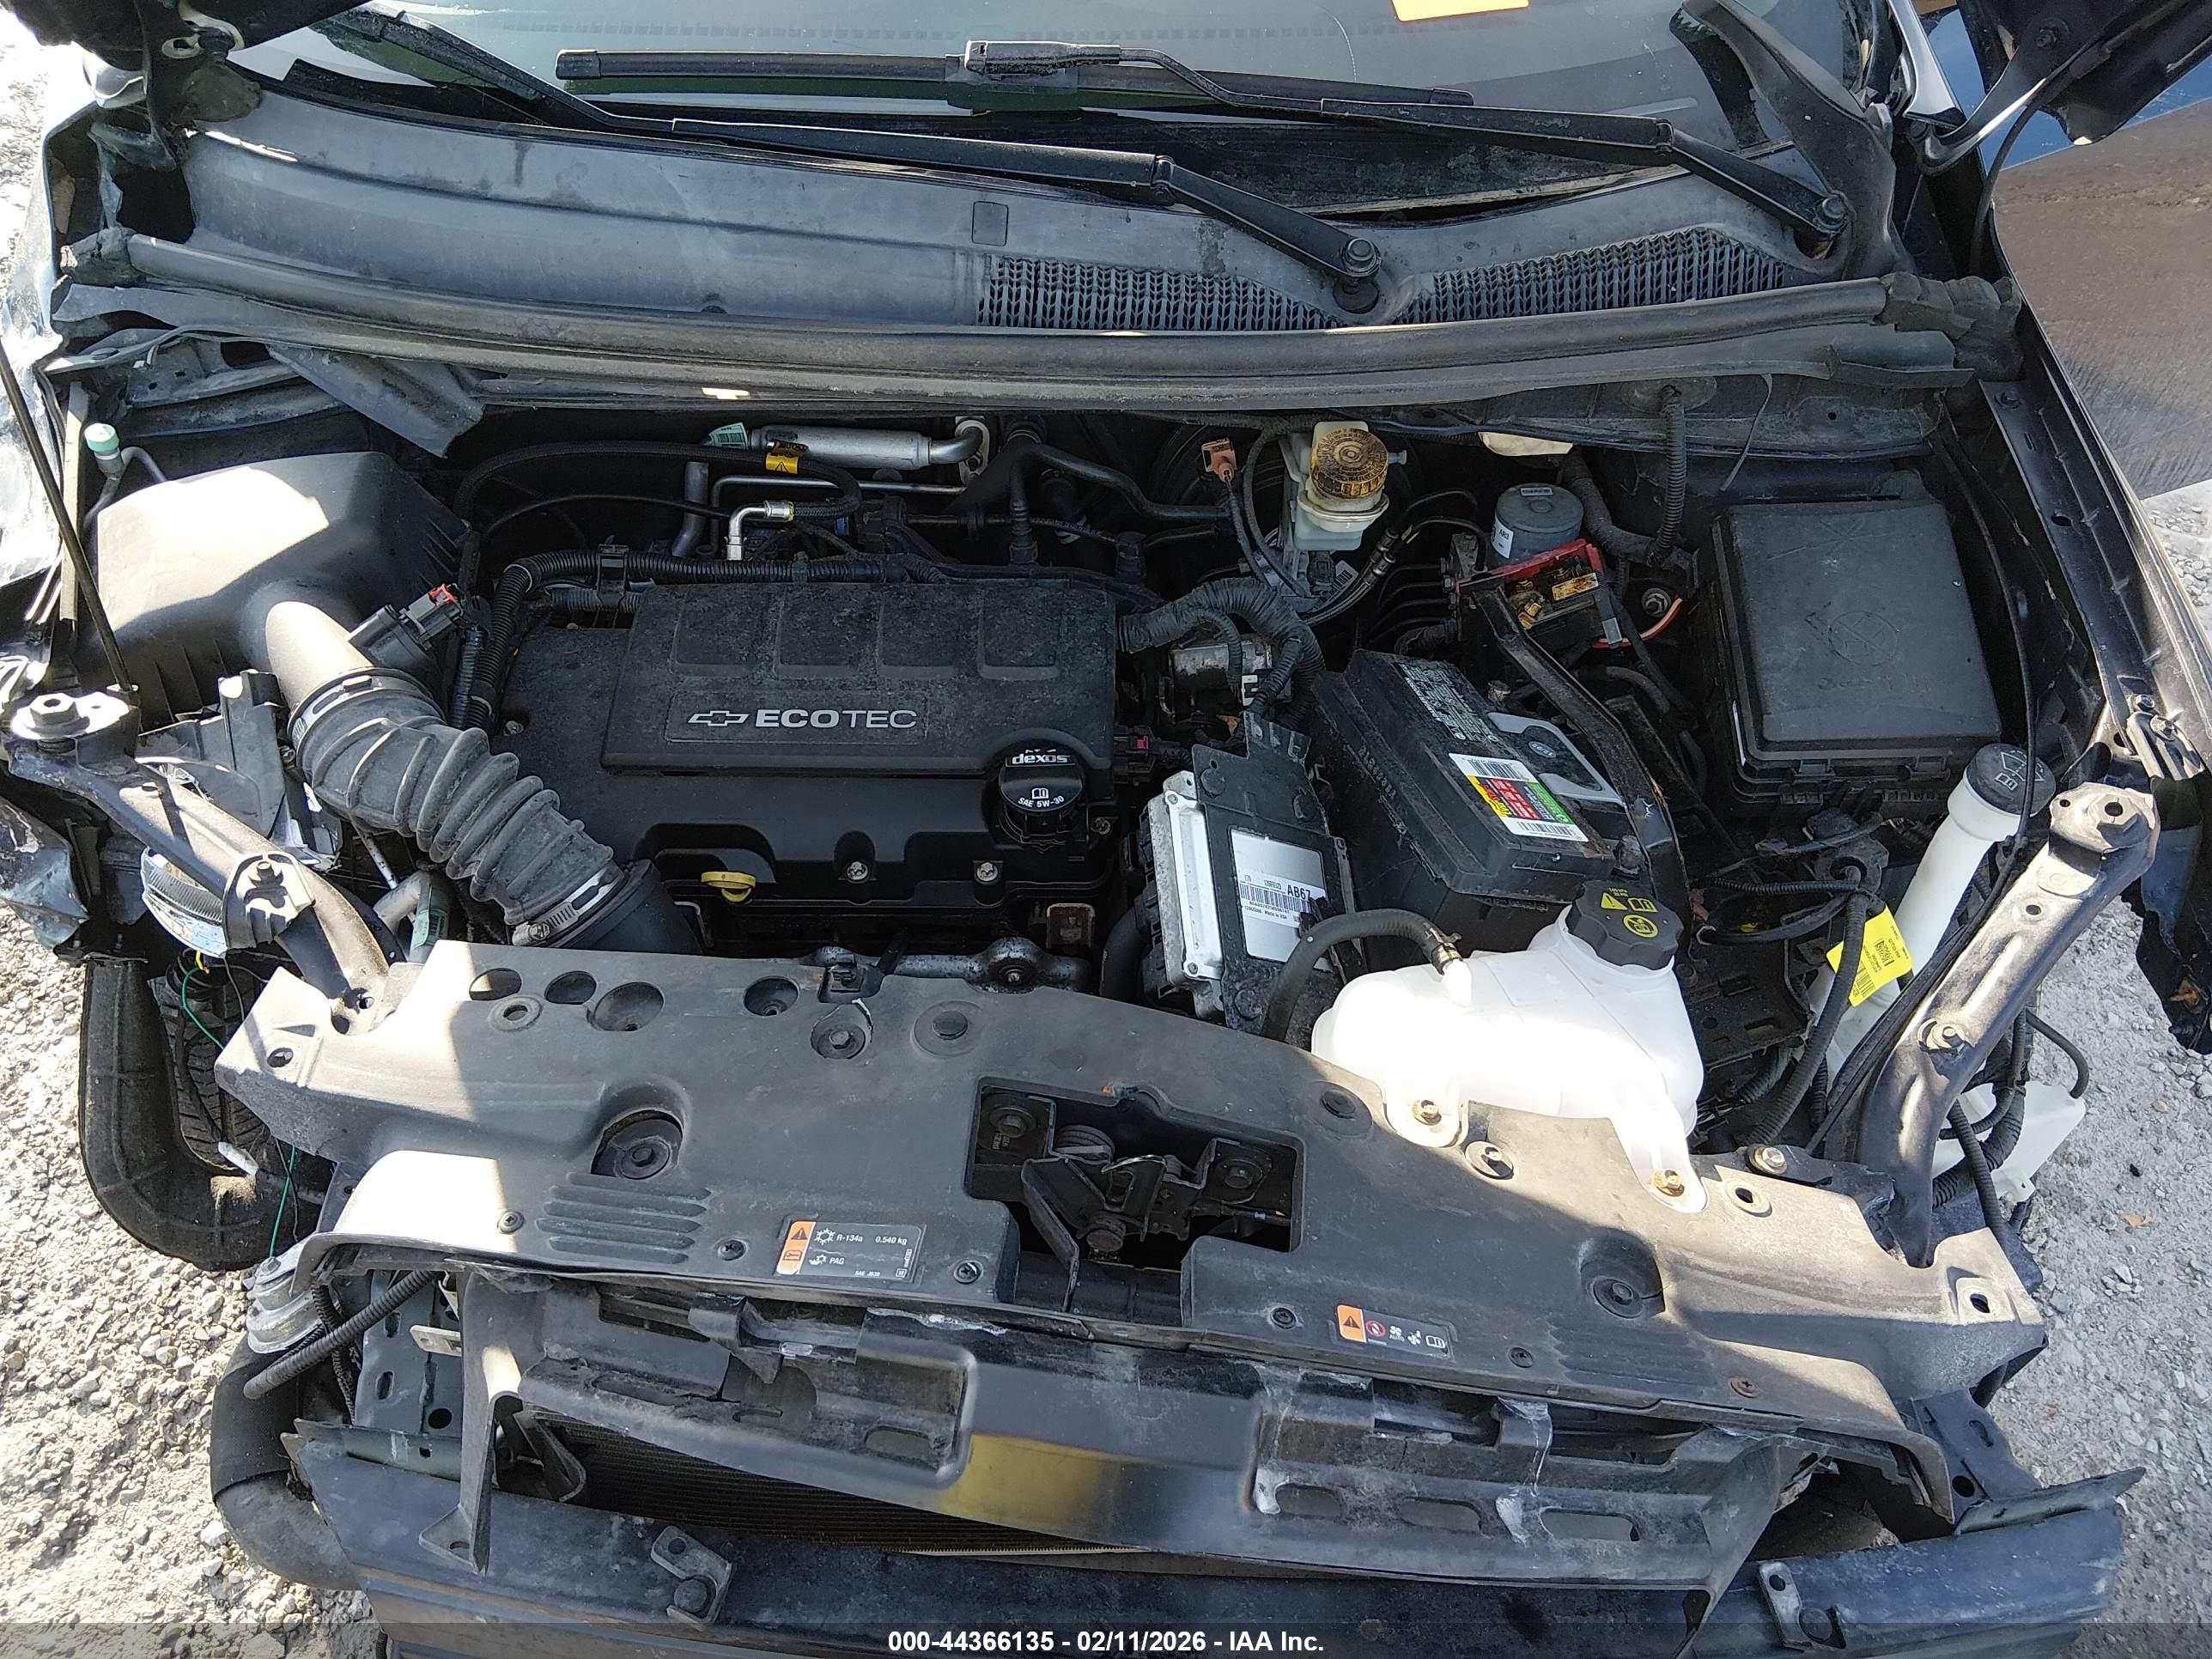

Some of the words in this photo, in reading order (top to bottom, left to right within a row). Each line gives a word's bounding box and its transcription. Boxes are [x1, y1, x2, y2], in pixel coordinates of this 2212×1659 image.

[1498, 528, 1509, 540] AR3
[755, 708, 917, 728] ECOTEC
[1012, 753, 1070, 764] dexos
[1018, 797, 1033, 807] SAE
[1036, 795, 1065, 807] 5W-30
[1287, 884, 1311, 900] AB67
[836, 1234, 863, 1243] R-134a
[875, 1235, 896, 1244] 0.540
[896, 1236, 907, 1246] kg
